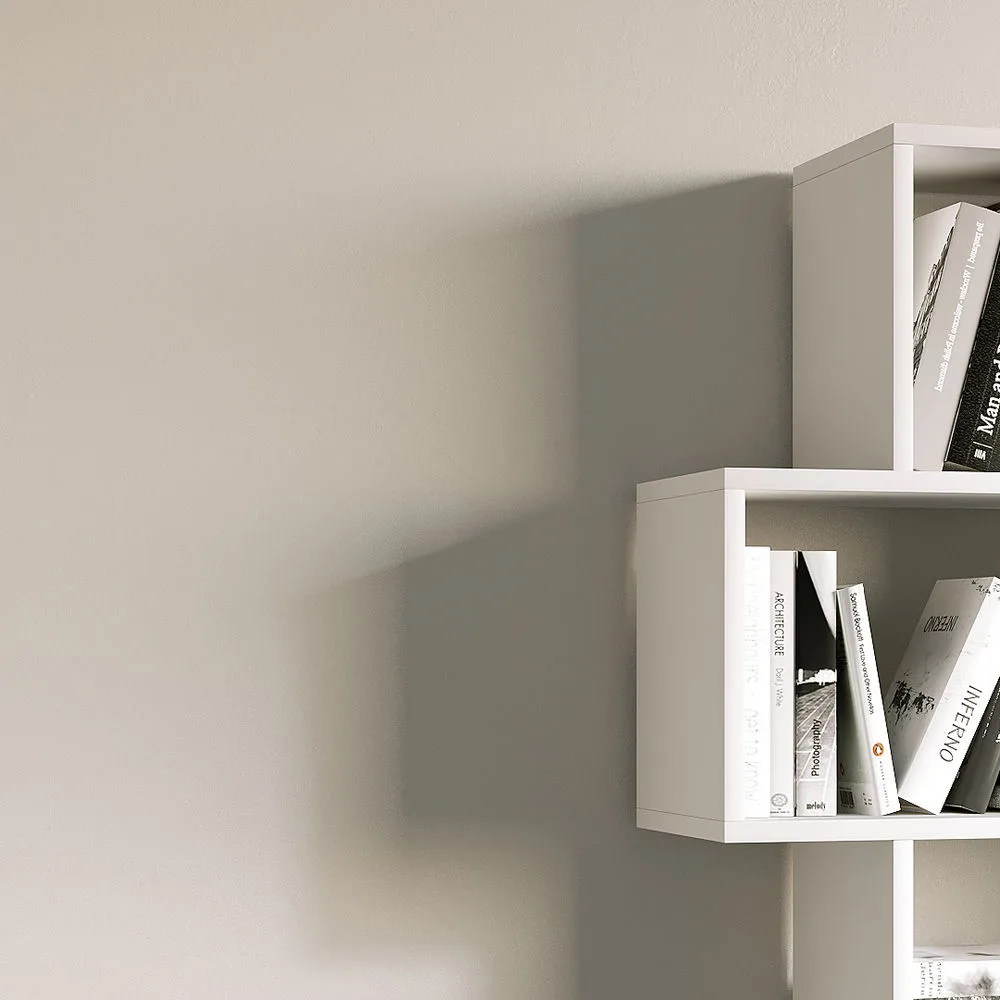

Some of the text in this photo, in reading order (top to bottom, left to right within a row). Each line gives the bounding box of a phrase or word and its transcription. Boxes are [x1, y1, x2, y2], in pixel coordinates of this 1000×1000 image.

[773, 592, 783, 655] ARCHITECTURE
[848, 592, 860, 617] Samuel
[923, 616, 958, 632] INFERNO
[810, 719, 822, 776] Photography
[936, 684, 983, 763] INFERNO
